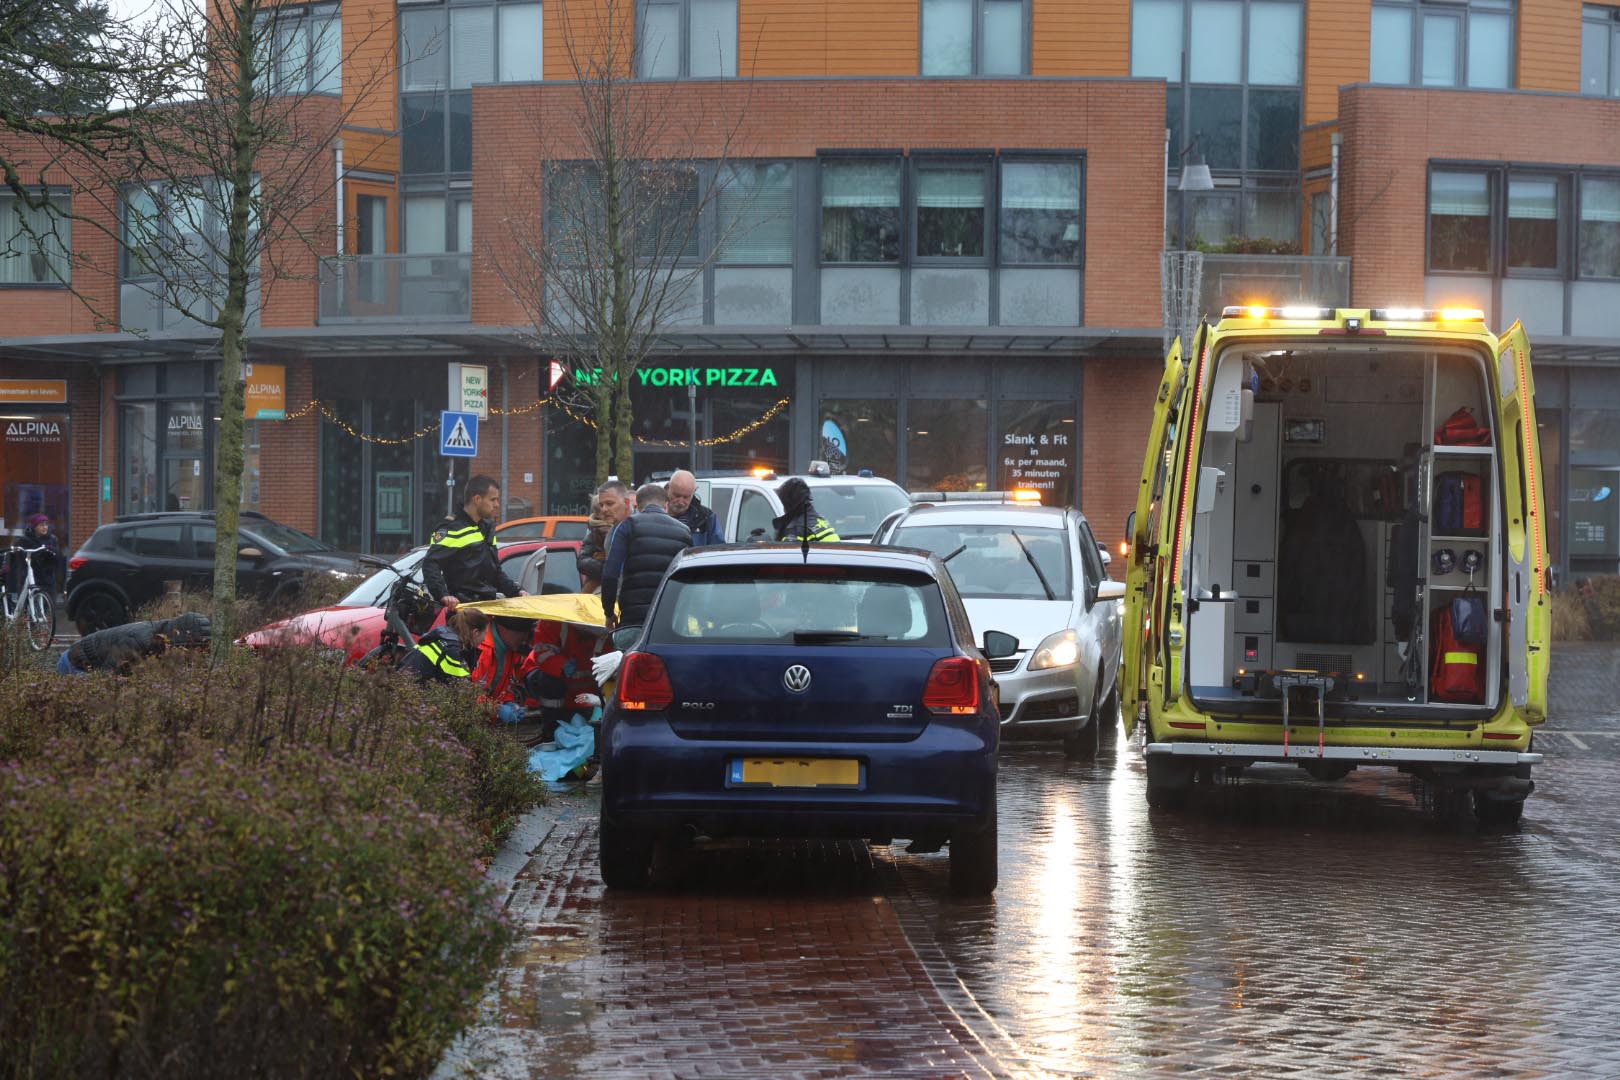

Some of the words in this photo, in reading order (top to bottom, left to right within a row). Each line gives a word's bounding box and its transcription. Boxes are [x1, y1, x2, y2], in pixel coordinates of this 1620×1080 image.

[465, 376, 481, 385] NEW
[636, 367, 702, 386] YORK
[705, 367, 778, 386] PIZZA
[248, 383, 281, 394] ALPINA
[464, 388, 482, 397] YORK
[464, 400, 484, 408] PIZZA
[168, 415, 203, 429] ALPINA
[6, 422, 60, 435] ALPINA
[1005, 433, 1035, 445] Slank
[1040, 434, 1048, 445] &
[1054, 434, 1068, 445] Fit
[1030, 447, 1039, 455] in
[1004, 457, 1015, 465] 6x
[1018, 459, 1032, 467] per
[1036, 458, 1067, 467] maand,
[1012, 469, 1022, 477] 35
[1024, 468, 1060, 477] minuten
[682, 702, 715, 710] POLO
[893, 705, 913, 713] TDI
